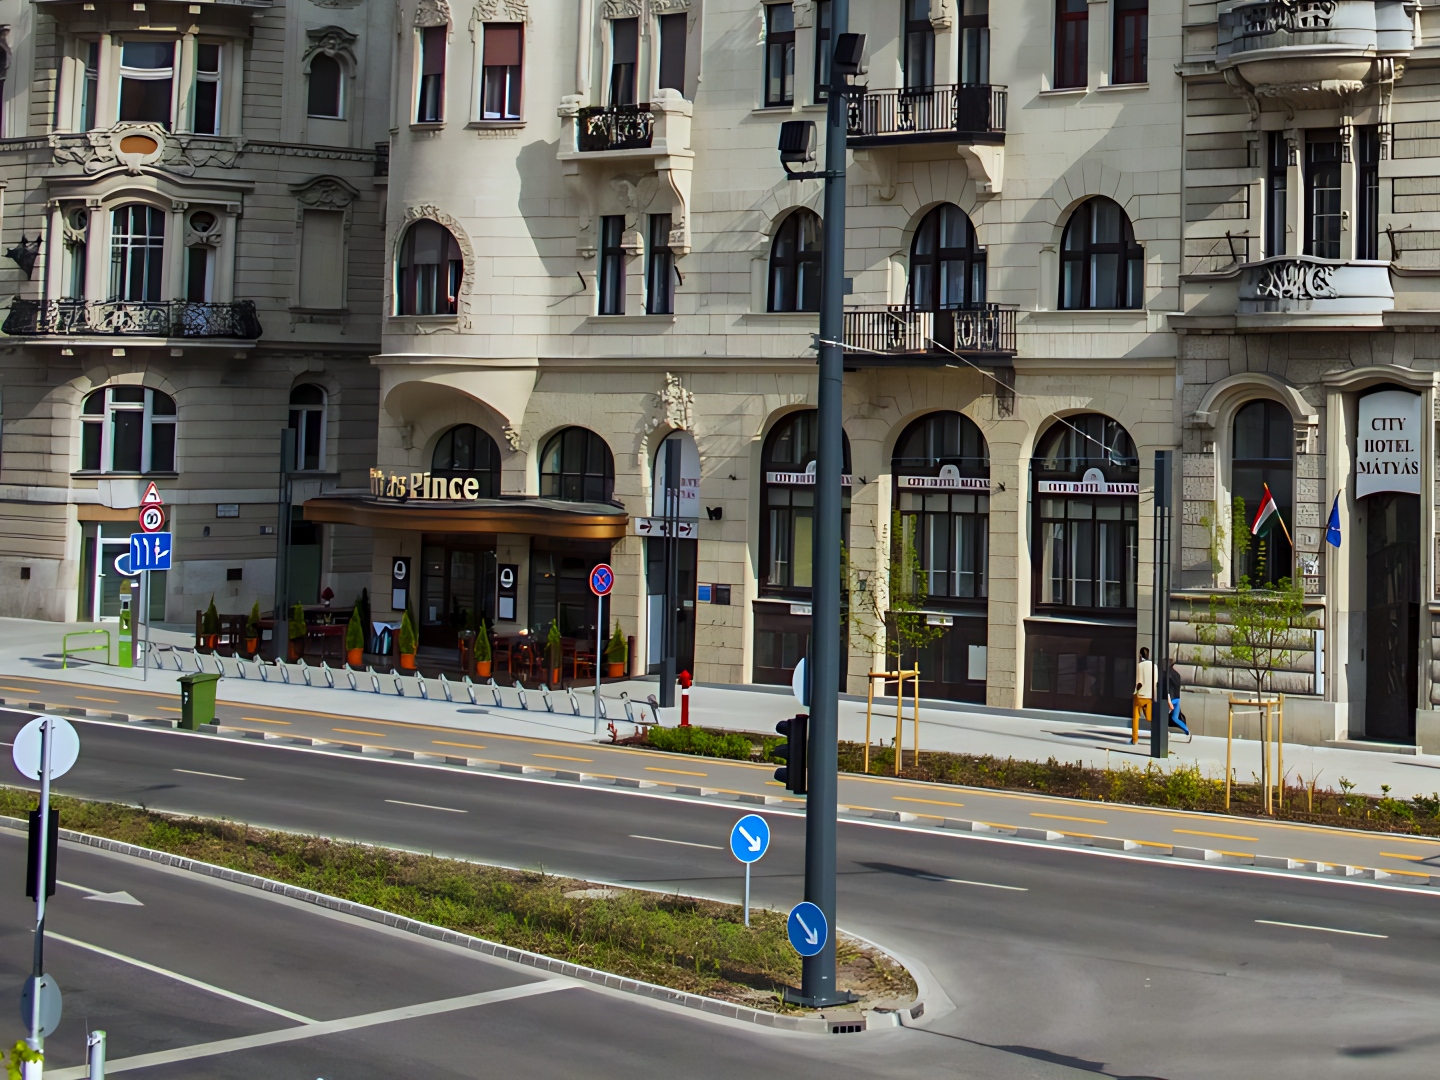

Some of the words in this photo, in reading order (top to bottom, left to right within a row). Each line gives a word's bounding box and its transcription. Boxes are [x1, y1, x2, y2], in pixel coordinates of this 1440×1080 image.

[1371, 417, 1407, 431] CITY
[1364, 439, 1415, 453] HOTEL
[1357, 457, 1419, 475] MÁTYÁS
[410, 471, 480, 500] Pince
